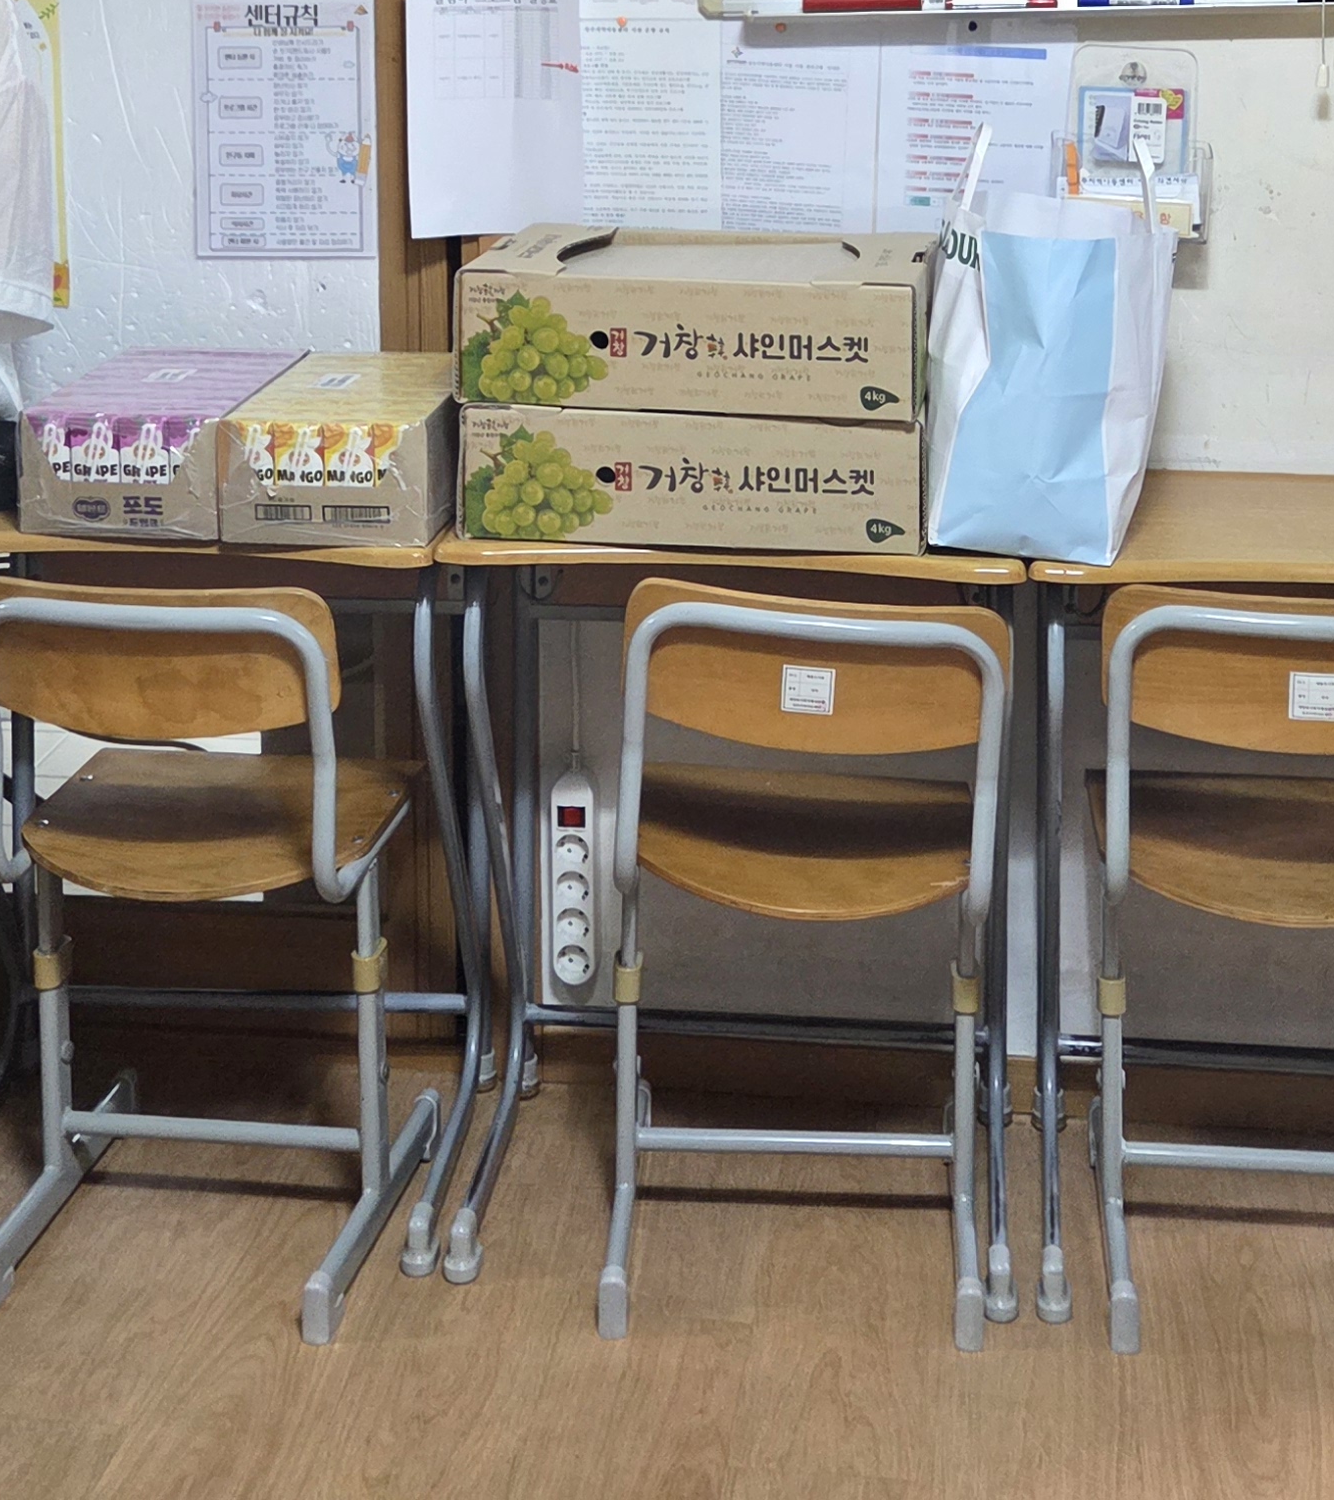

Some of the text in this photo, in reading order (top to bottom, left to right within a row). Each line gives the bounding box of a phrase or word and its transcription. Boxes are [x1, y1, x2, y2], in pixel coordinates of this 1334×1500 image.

[244, 4, 318, 27] 센터규칙
[732, 331, 869, 363] 샤인머스켓
[697, 370, 811, 382] GEOCHANG GRAPE
[864, 391, 886, 404] 4kg
[738, 465, 875, 496] 샤인머스켓
[123, 495, 163, 515] 포도
[702, 504, 818, 515] GEOCHANG GRAPE
[870, 522, 892, 535] 4kg
